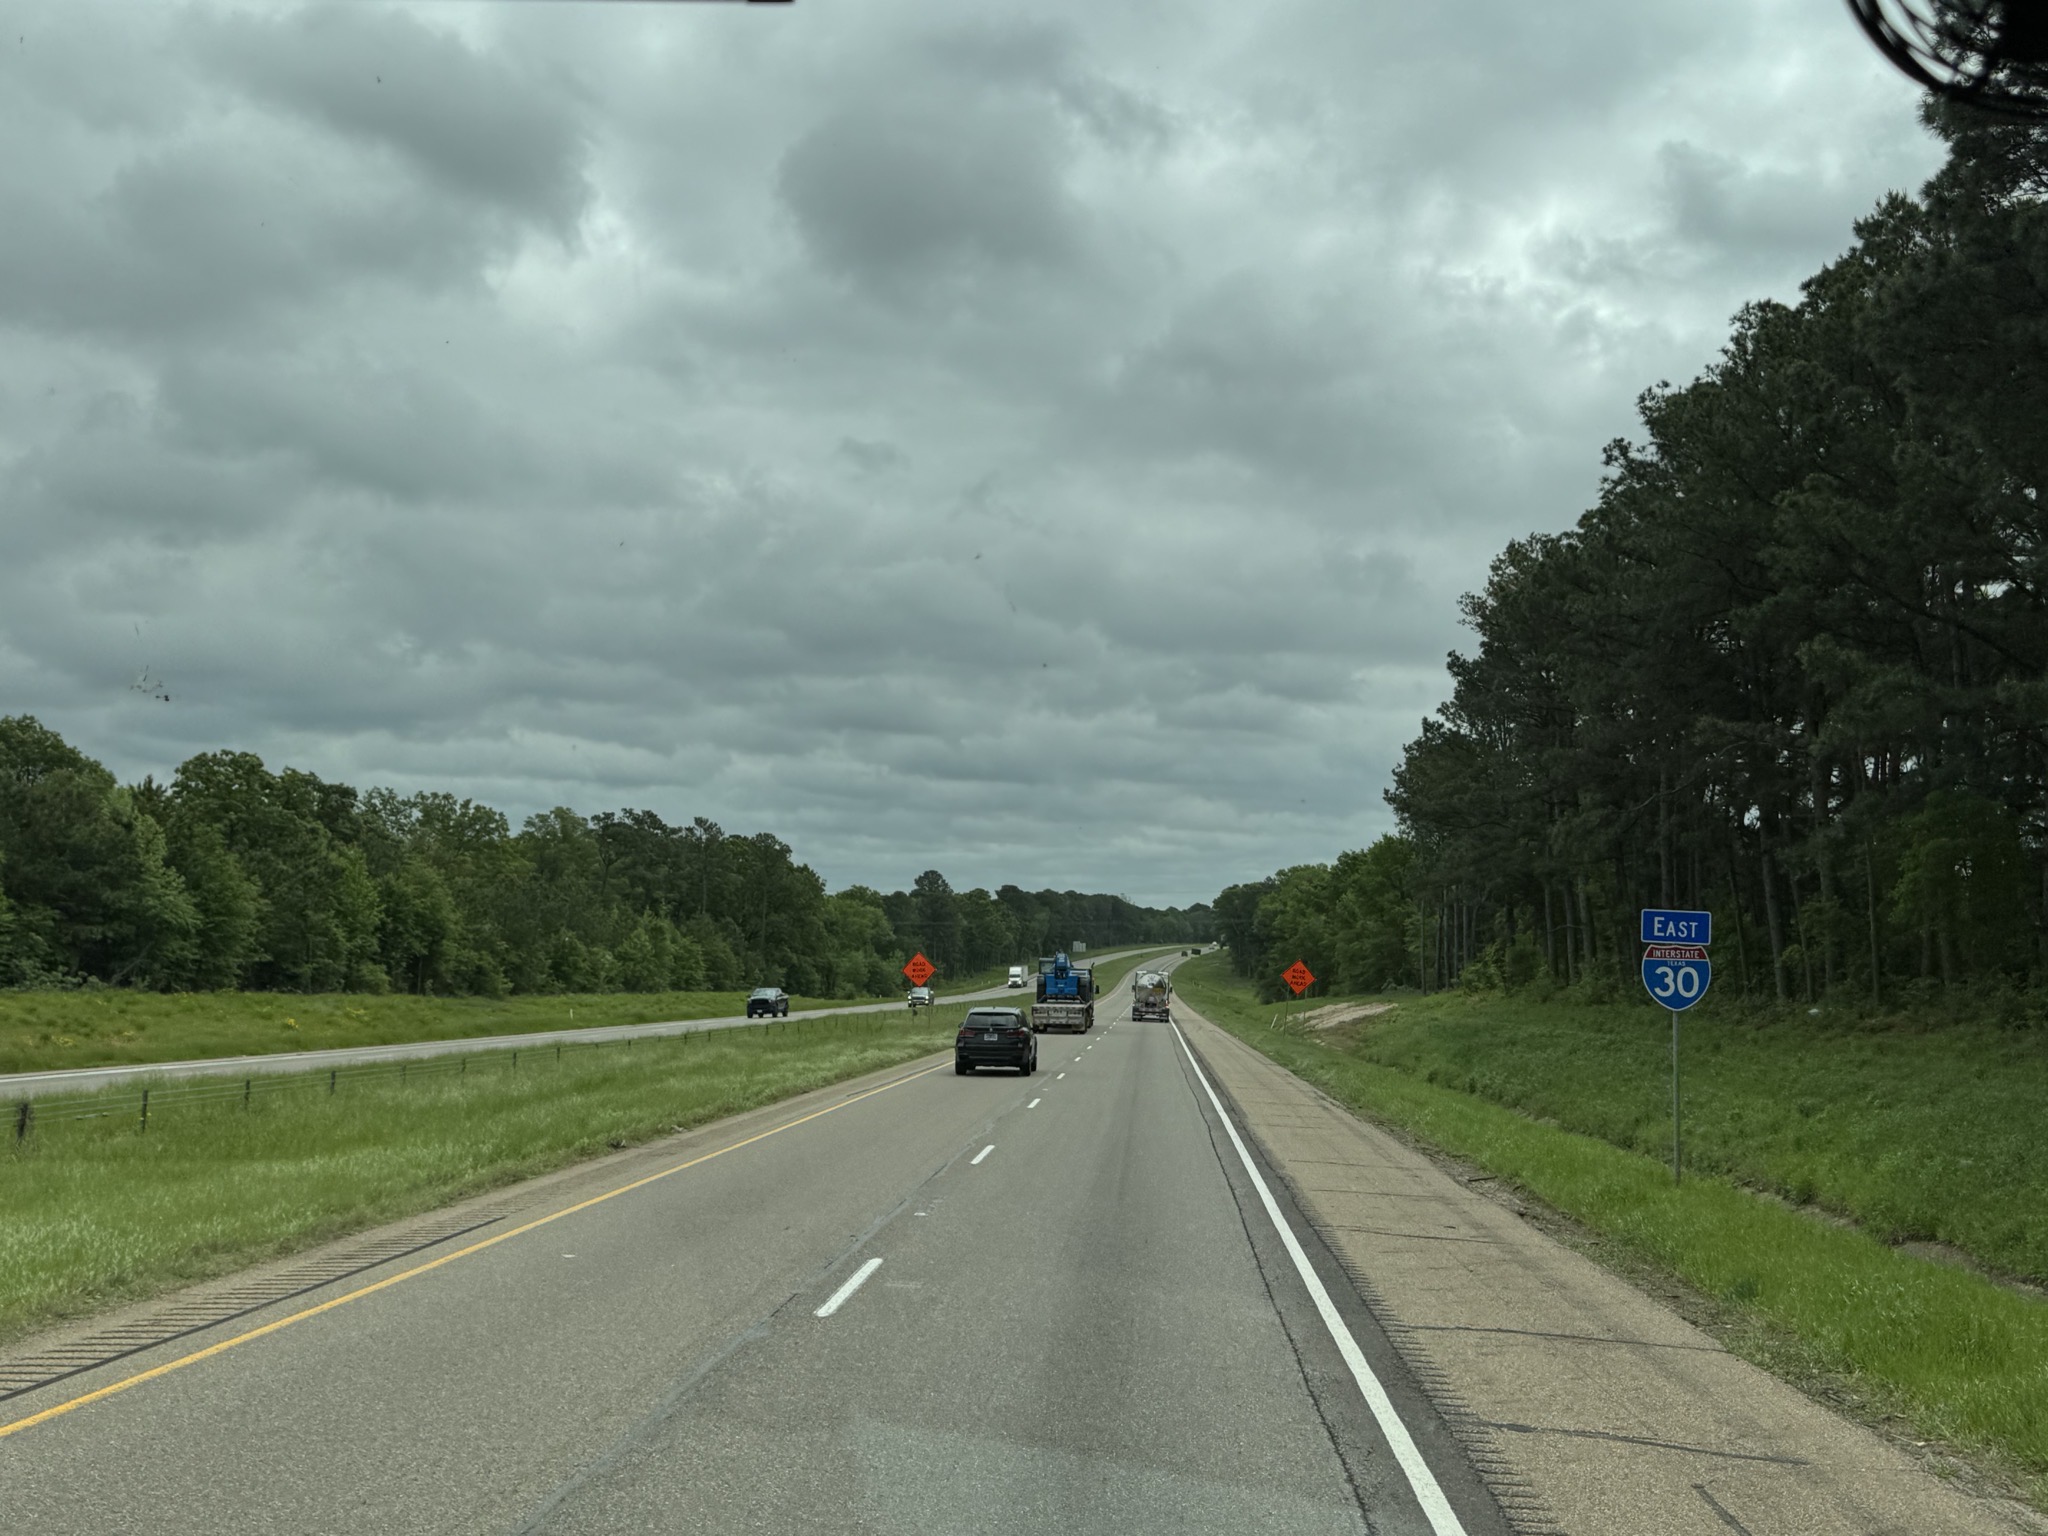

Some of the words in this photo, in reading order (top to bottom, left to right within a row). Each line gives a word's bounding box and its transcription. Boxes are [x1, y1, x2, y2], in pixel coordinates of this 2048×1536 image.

[1653, 917, 1698, 938] EAST
[1652, 949, 1700, 958] INTERSTATE
[1654, 966, 1699, 998] 30
